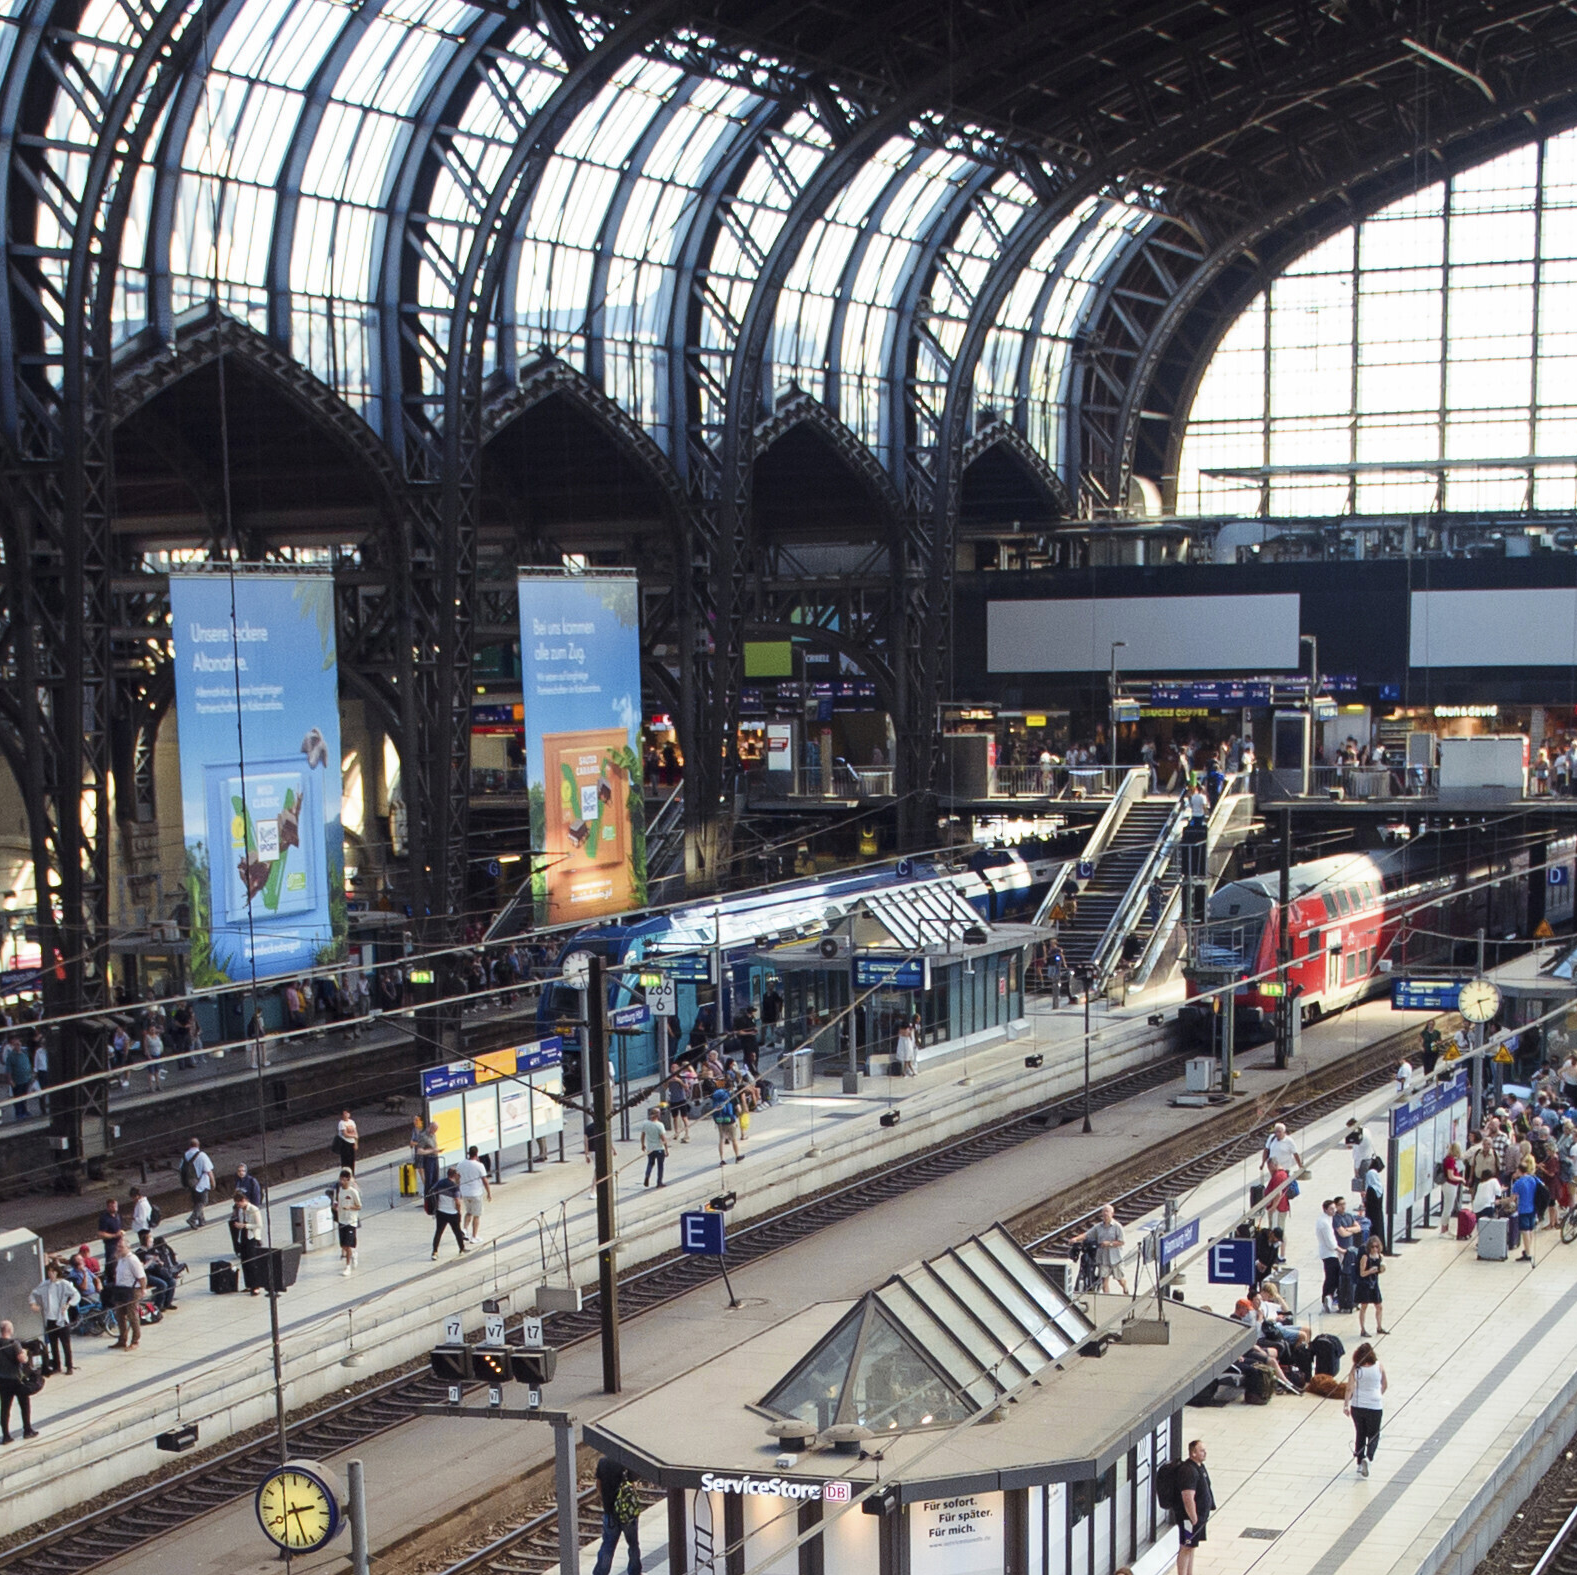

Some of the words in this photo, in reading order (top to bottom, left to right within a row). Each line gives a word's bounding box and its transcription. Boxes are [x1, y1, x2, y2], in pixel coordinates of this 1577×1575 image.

[190, 622, 229, 643] Unsere
[533, 618, 546, 636] Bei
[547, 623, 561, 636] uns
[562, 617, 595, 636] kommen
[568, 642, 586, 665] Zug.
[1175, 708, 1209, 718] COFFEE
[1080, 864, 1091, 877] C
[1550, 867, 1561, 884] D
[656, 998, 665, 1011] 6
[686, 1216, 706, 1248] E
[1214, 1244, 1235, 1278] E
[447, 1322, 460, 1336] r7
[487, 1324, 503, 1338] v7
[527, 1326, 540, 1339] t7
[701, 1472, 822, 1500] ServiceStore
[827, 1486, 847, 1499] DB
[924, 1502, 940, 1512] Für
[943, 1497, 978, 1510] sofort.
[939, 1513, 957, 1523] Für
[958, 1509, 993, 1522] später.
[929, 1528, 946, 1538] Für
[948, 1524, 976, 1535] mich.
